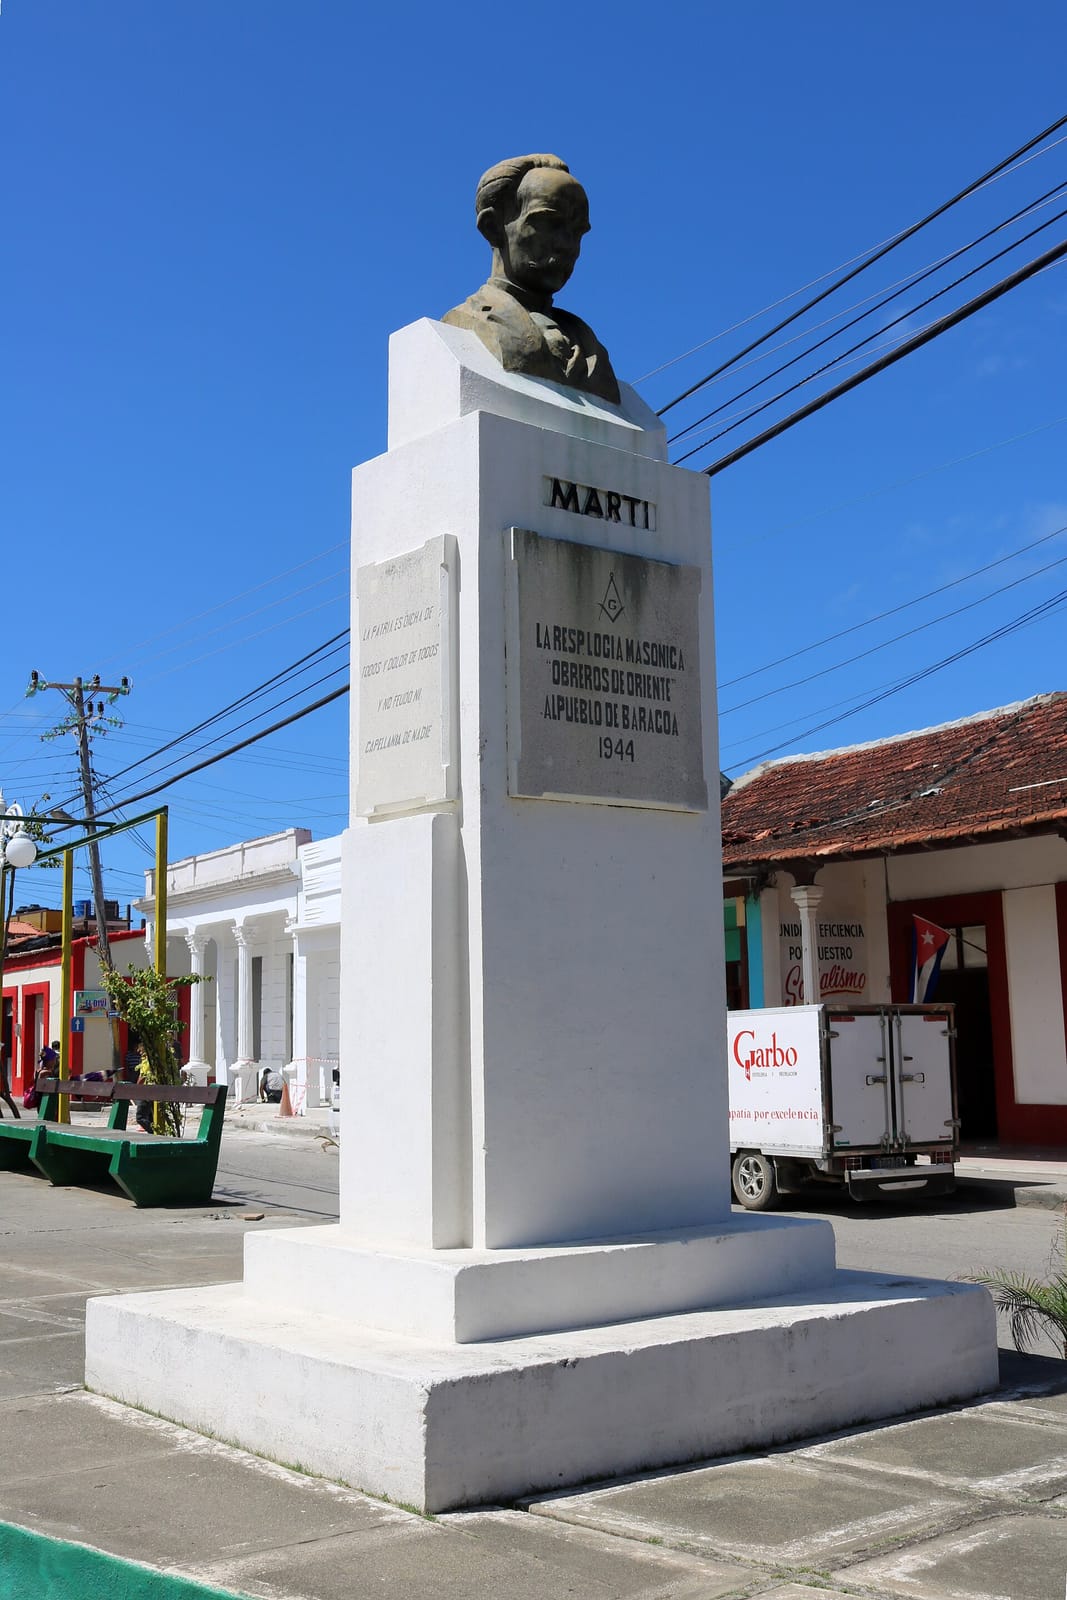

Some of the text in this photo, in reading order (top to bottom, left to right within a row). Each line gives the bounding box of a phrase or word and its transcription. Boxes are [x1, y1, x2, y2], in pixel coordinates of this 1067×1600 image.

[551, 477, 649, 529] MARTI
[608, 600, 616, 610] G
[362, 605, 435, 641] LA PATRIA ES DICHA DE
[536, 622, 551, 650] LA
[625, 638, 685, 671] MASONICA
[361, 661, 382, 679] TODOS
[387, 653, 409, 671] DOLOR
[408, 650, 418, 664] DE
[418, 642, 439, 662] TODOS
[611, 668, 625, 694] DE
[383, 697, 393, 710] NO
[543, 694, 679, 736] AL PUEBLO DE BARACOA
[402, 730, 412, 744] DE
[411, 725, 433, 742] NADIE
[599, 736, 635, 763] 1944
[818, 923, 864, 938] EFICIENCIA
[789, 946, 853, 960] PO UESTRO
[733, 1030, 798, 1076] Garbo
[754, 1110, 770, 1121] por
[771, 1108, 819, 1120] excelencia
